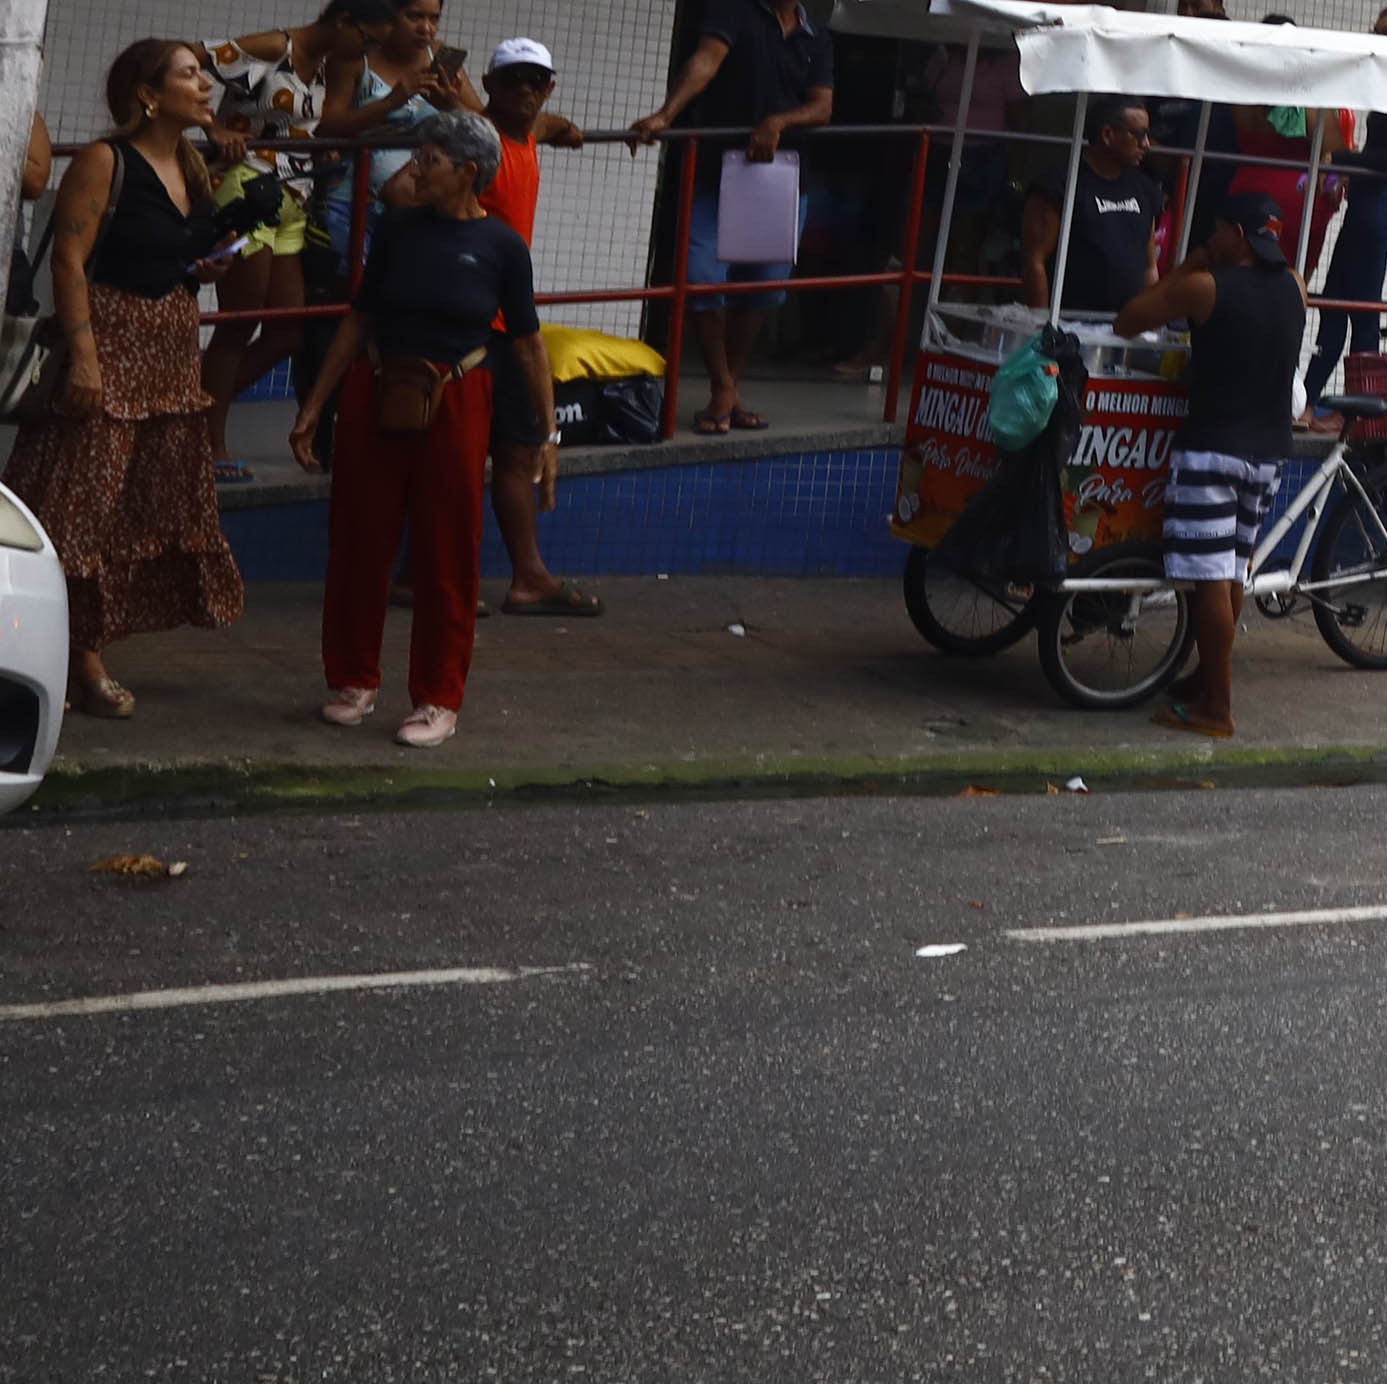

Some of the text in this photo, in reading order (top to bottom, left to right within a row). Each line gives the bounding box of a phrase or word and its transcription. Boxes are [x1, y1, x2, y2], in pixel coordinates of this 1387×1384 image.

[554, 402, 584, 425] on
[914, 386, 981, 437] MINGAU
[1086, 391, 1096, 412] O
[1098, 391, 1149, 415] MELHOR
[1067, 424, 1176, 471] INGAU
